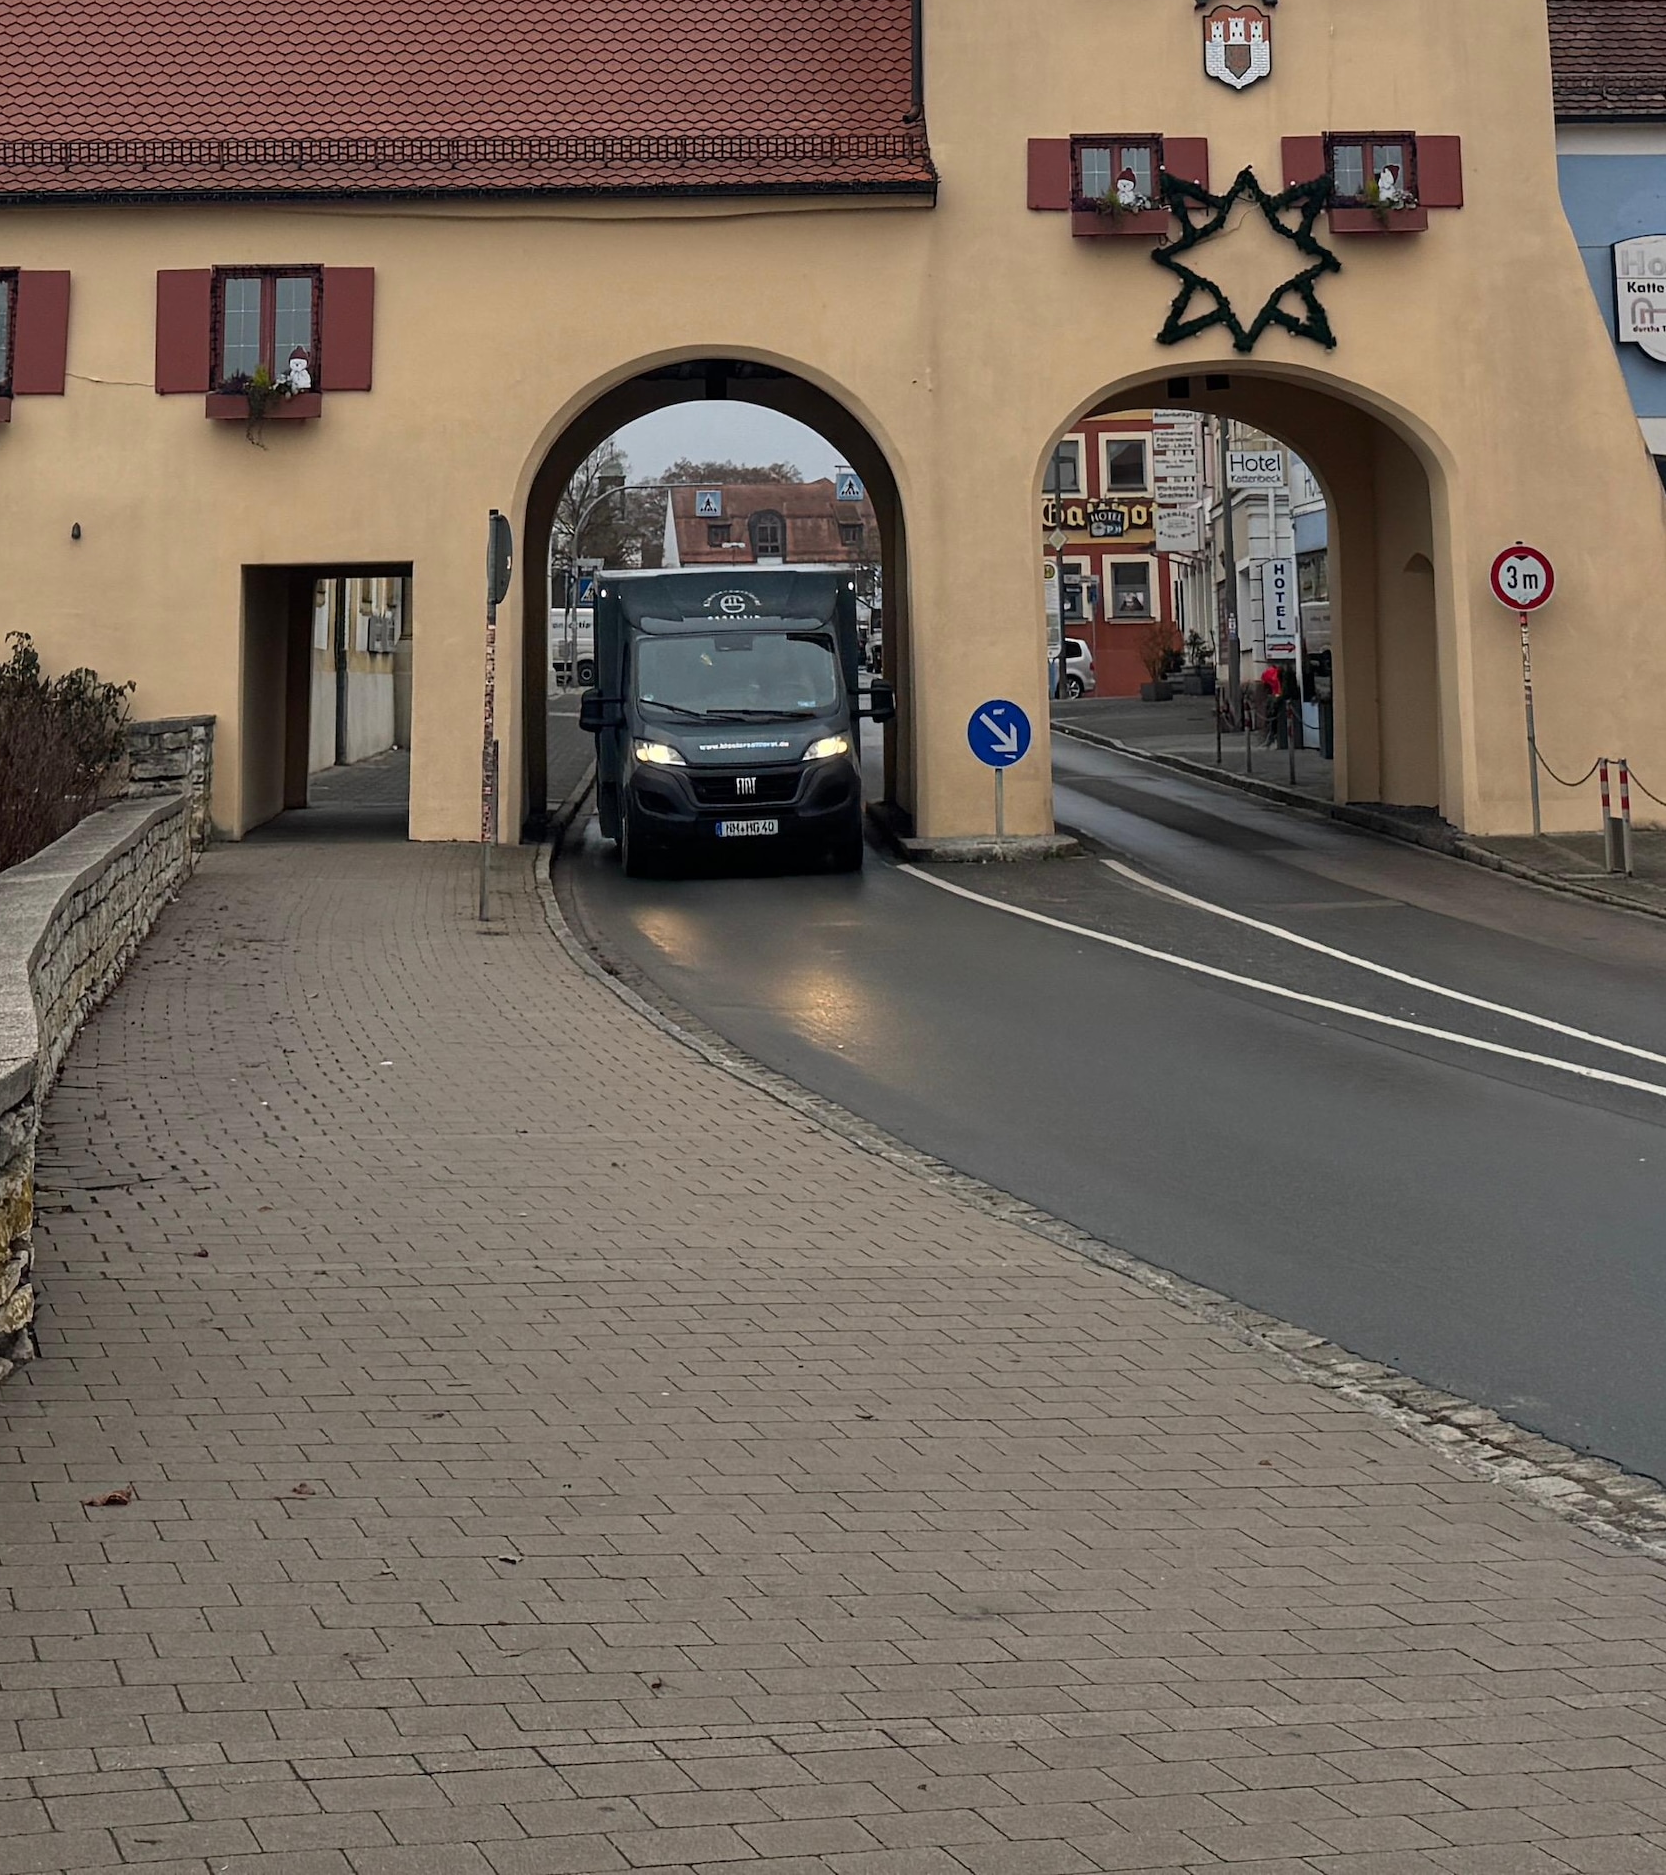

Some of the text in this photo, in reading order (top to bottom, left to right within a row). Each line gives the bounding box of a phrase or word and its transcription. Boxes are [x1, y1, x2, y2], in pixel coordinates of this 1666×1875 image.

[1230, 453, 1281, 472] Hotel
[1231, 474, 1281, 483] Kattenbeck
[1090, 511, 1122, 523] HOTEL
[1507, 565, 1538, 589] 3 m
[1274, 563, 1286, 631] HOTEL
[736, 777, 756, 795] FIAT
